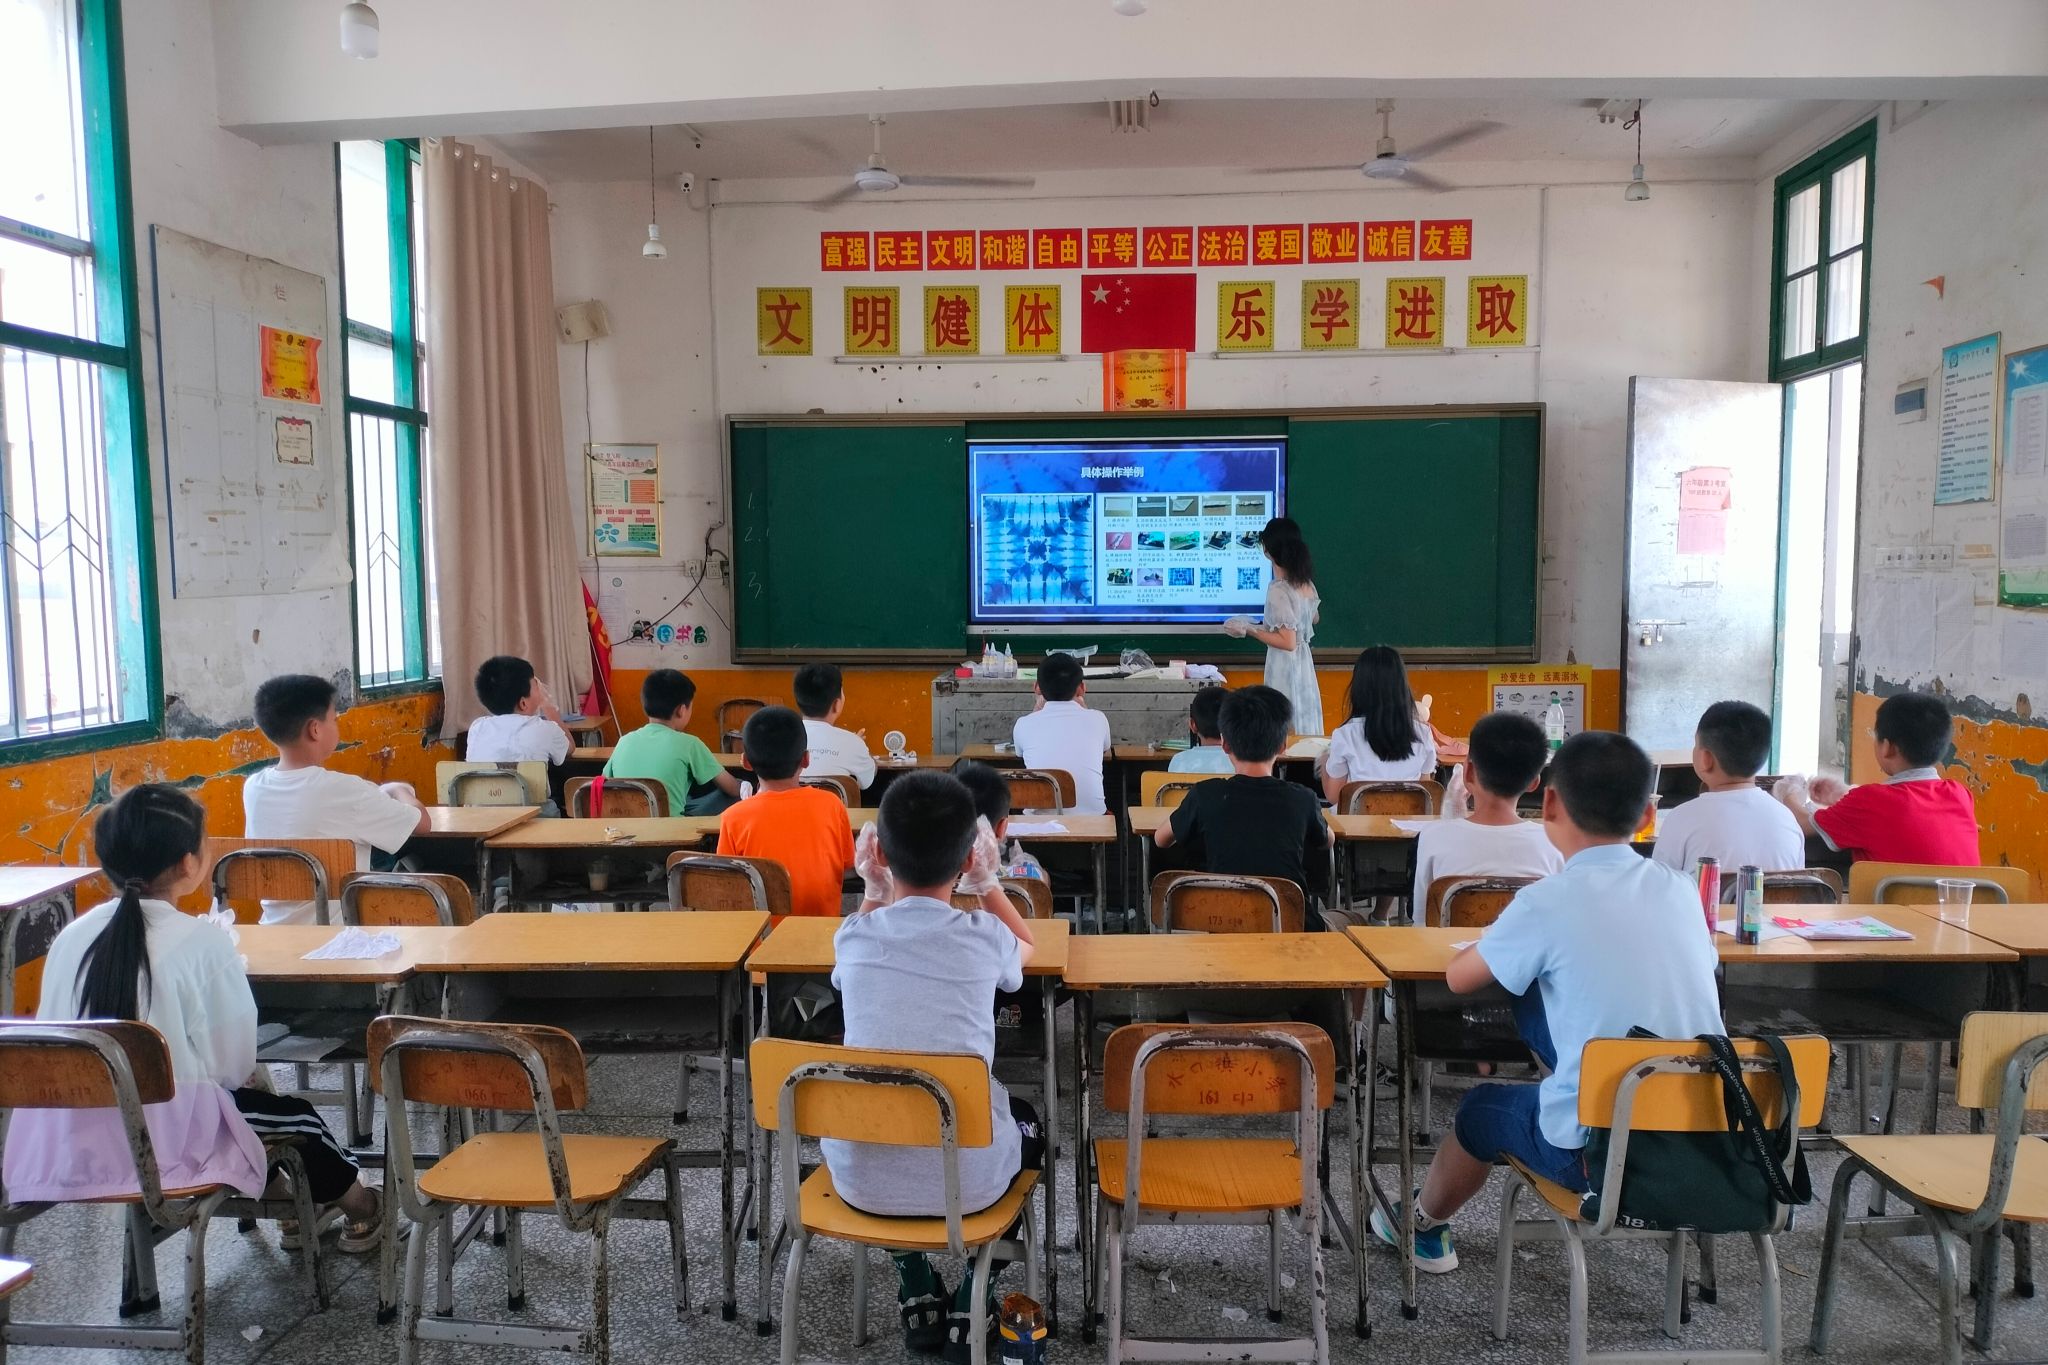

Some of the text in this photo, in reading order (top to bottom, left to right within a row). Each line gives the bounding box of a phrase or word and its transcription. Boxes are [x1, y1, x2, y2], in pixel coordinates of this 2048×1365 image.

[823, 225, 1469, 267] 富强 民主 文明 和谐 自由 平等 公正 法治 爱国 敬业 诚信 友善
[1081, 466, 1144, 478] 具体操作举例
[1500, 671, 1579, 682] 珍爱生命 远离溺水
[1751, 1126, 1766, 1157] MUSEUM
[1762, 1155, 1781, 1185] SUZHOU
